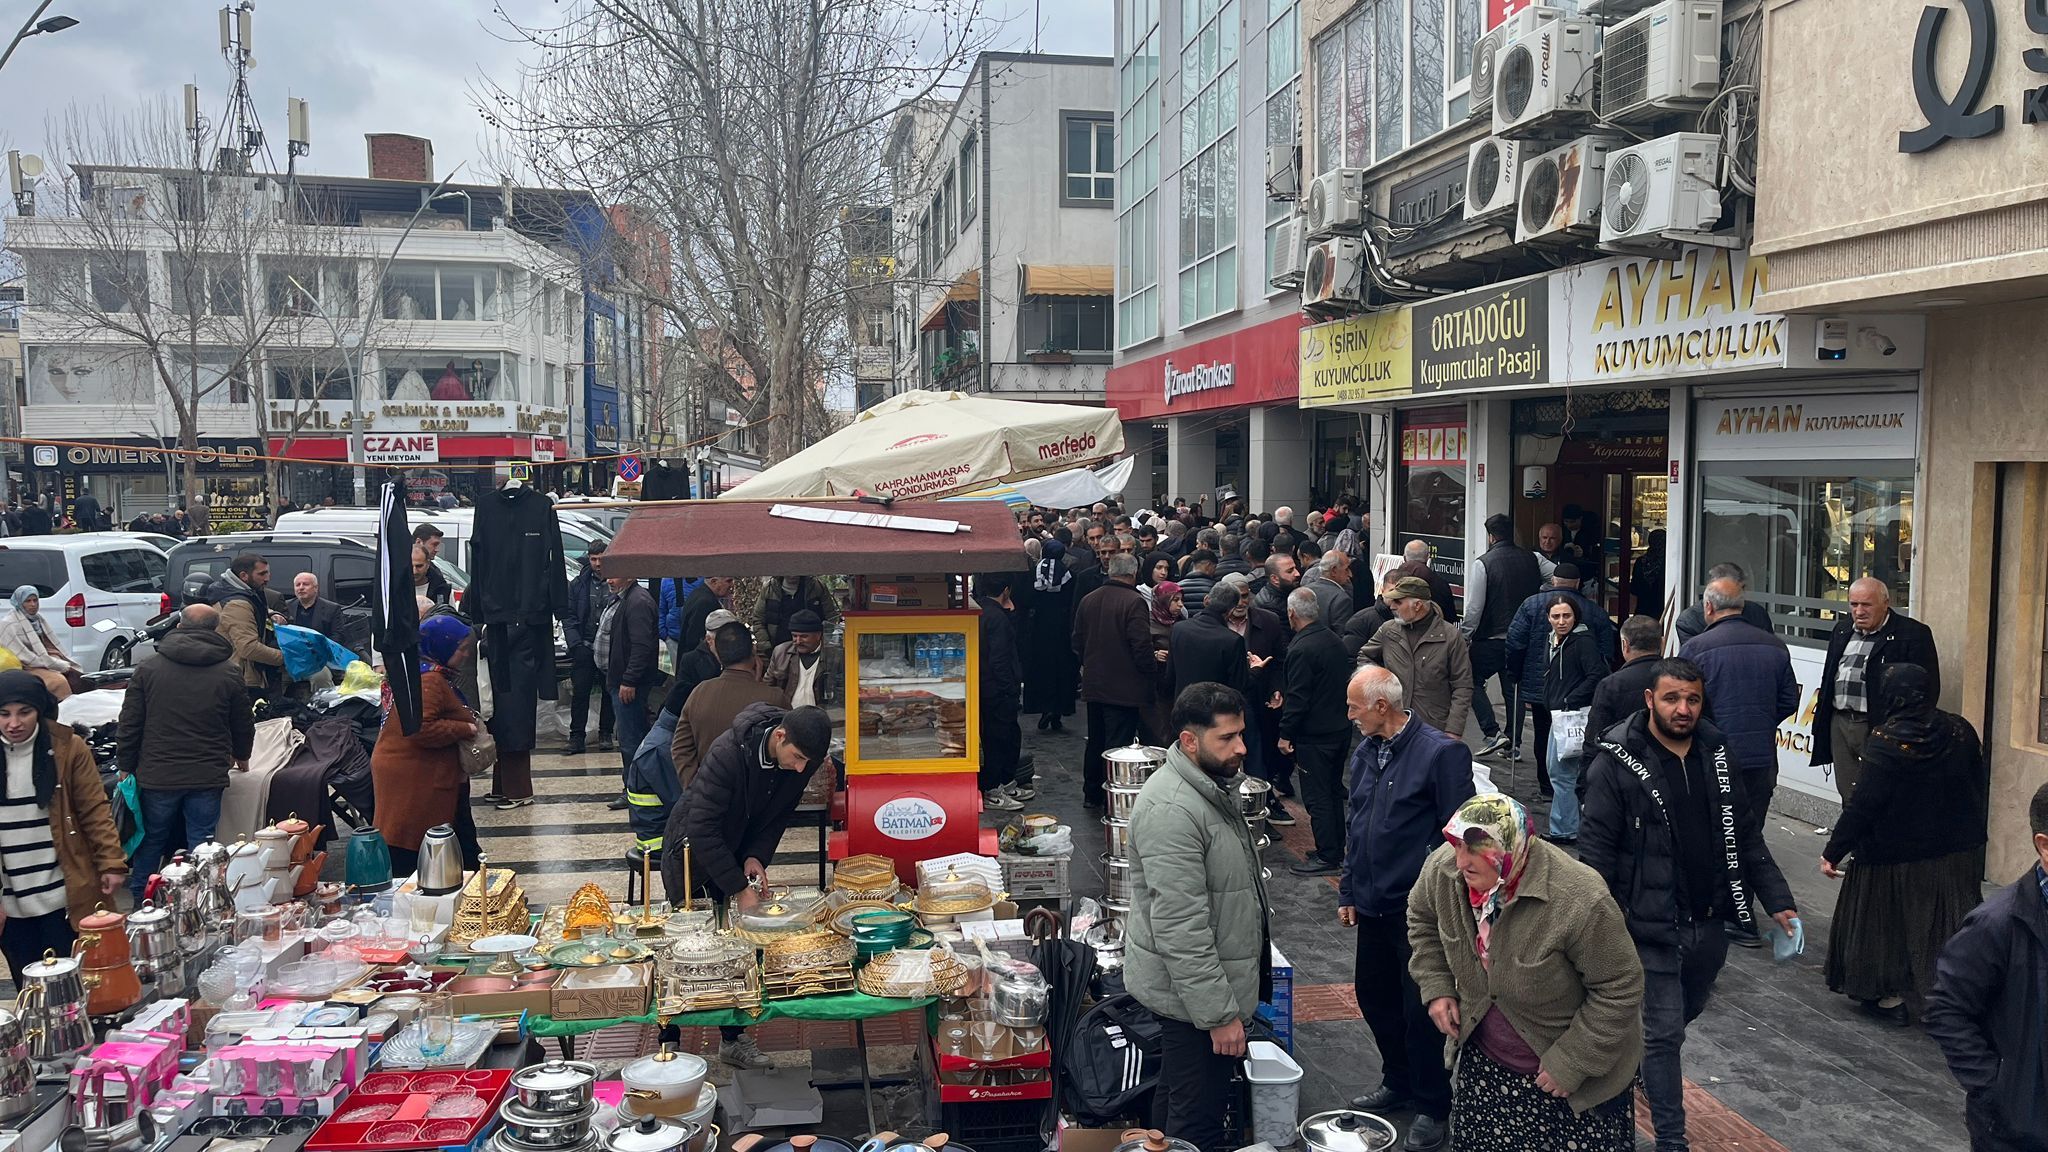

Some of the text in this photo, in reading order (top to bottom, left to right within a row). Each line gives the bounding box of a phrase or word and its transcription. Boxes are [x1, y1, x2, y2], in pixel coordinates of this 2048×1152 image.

[1541, 33, 1551, 88] arçelik
[1431, 291, 1527, 352] ORTADOĞU
[1335, 324, 1367, 360] ŞİRİN
[1595, 317, 1786, 374] KUYUMCULUK
[1171, 360, 1235, 396] Ziraat Bankası
[1314, 360, 1391, 387] KUYUMCULUK
[1420, 345, 1541, 391] Kuyumcular Pasajı
[1717, 404, 1904, 435] AYHAN KUYUMCULUK
[1039, 432, 1096, 460] marfedo
[875, 464, 971, 492] KAHRAMANMARAŞ
[892, 477, 957, 498] DONDURMASI
[882, 816, 933, 829] BATMAN
[1721, 805, 1739, 869] MONCLER
